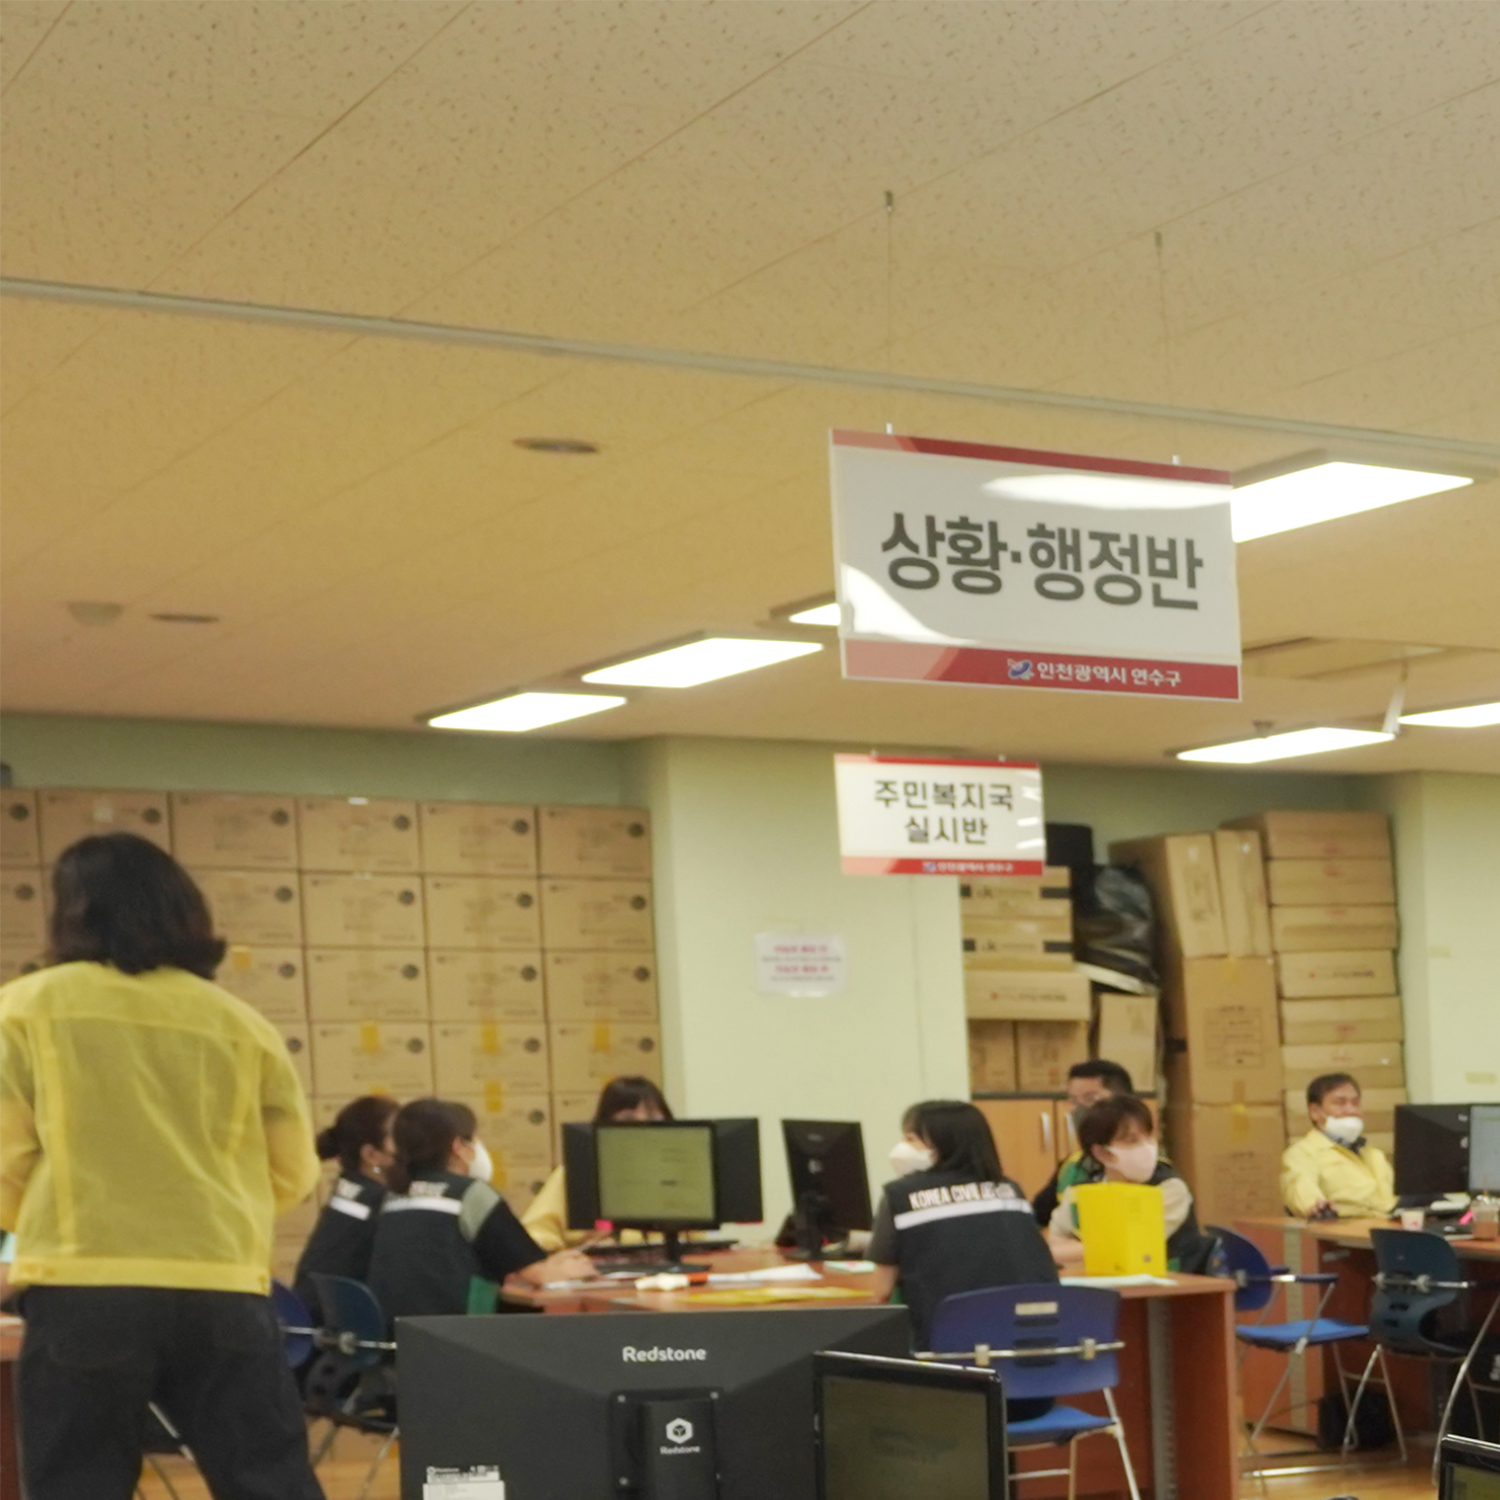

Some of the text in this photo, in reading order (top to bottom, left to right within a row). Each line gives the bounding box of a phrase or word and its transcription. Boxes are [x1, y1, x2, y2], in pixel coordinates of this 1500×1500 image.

[882, 512, 1203, 610] 상황·행정반
[1036, 661, 1182, 688] 인천광역시 연수구
[874, 779, 1014, 811] 주민복지국
[905, 816, 988, 845] 실시반
[622, 1345, 707, 1363] Redstone
